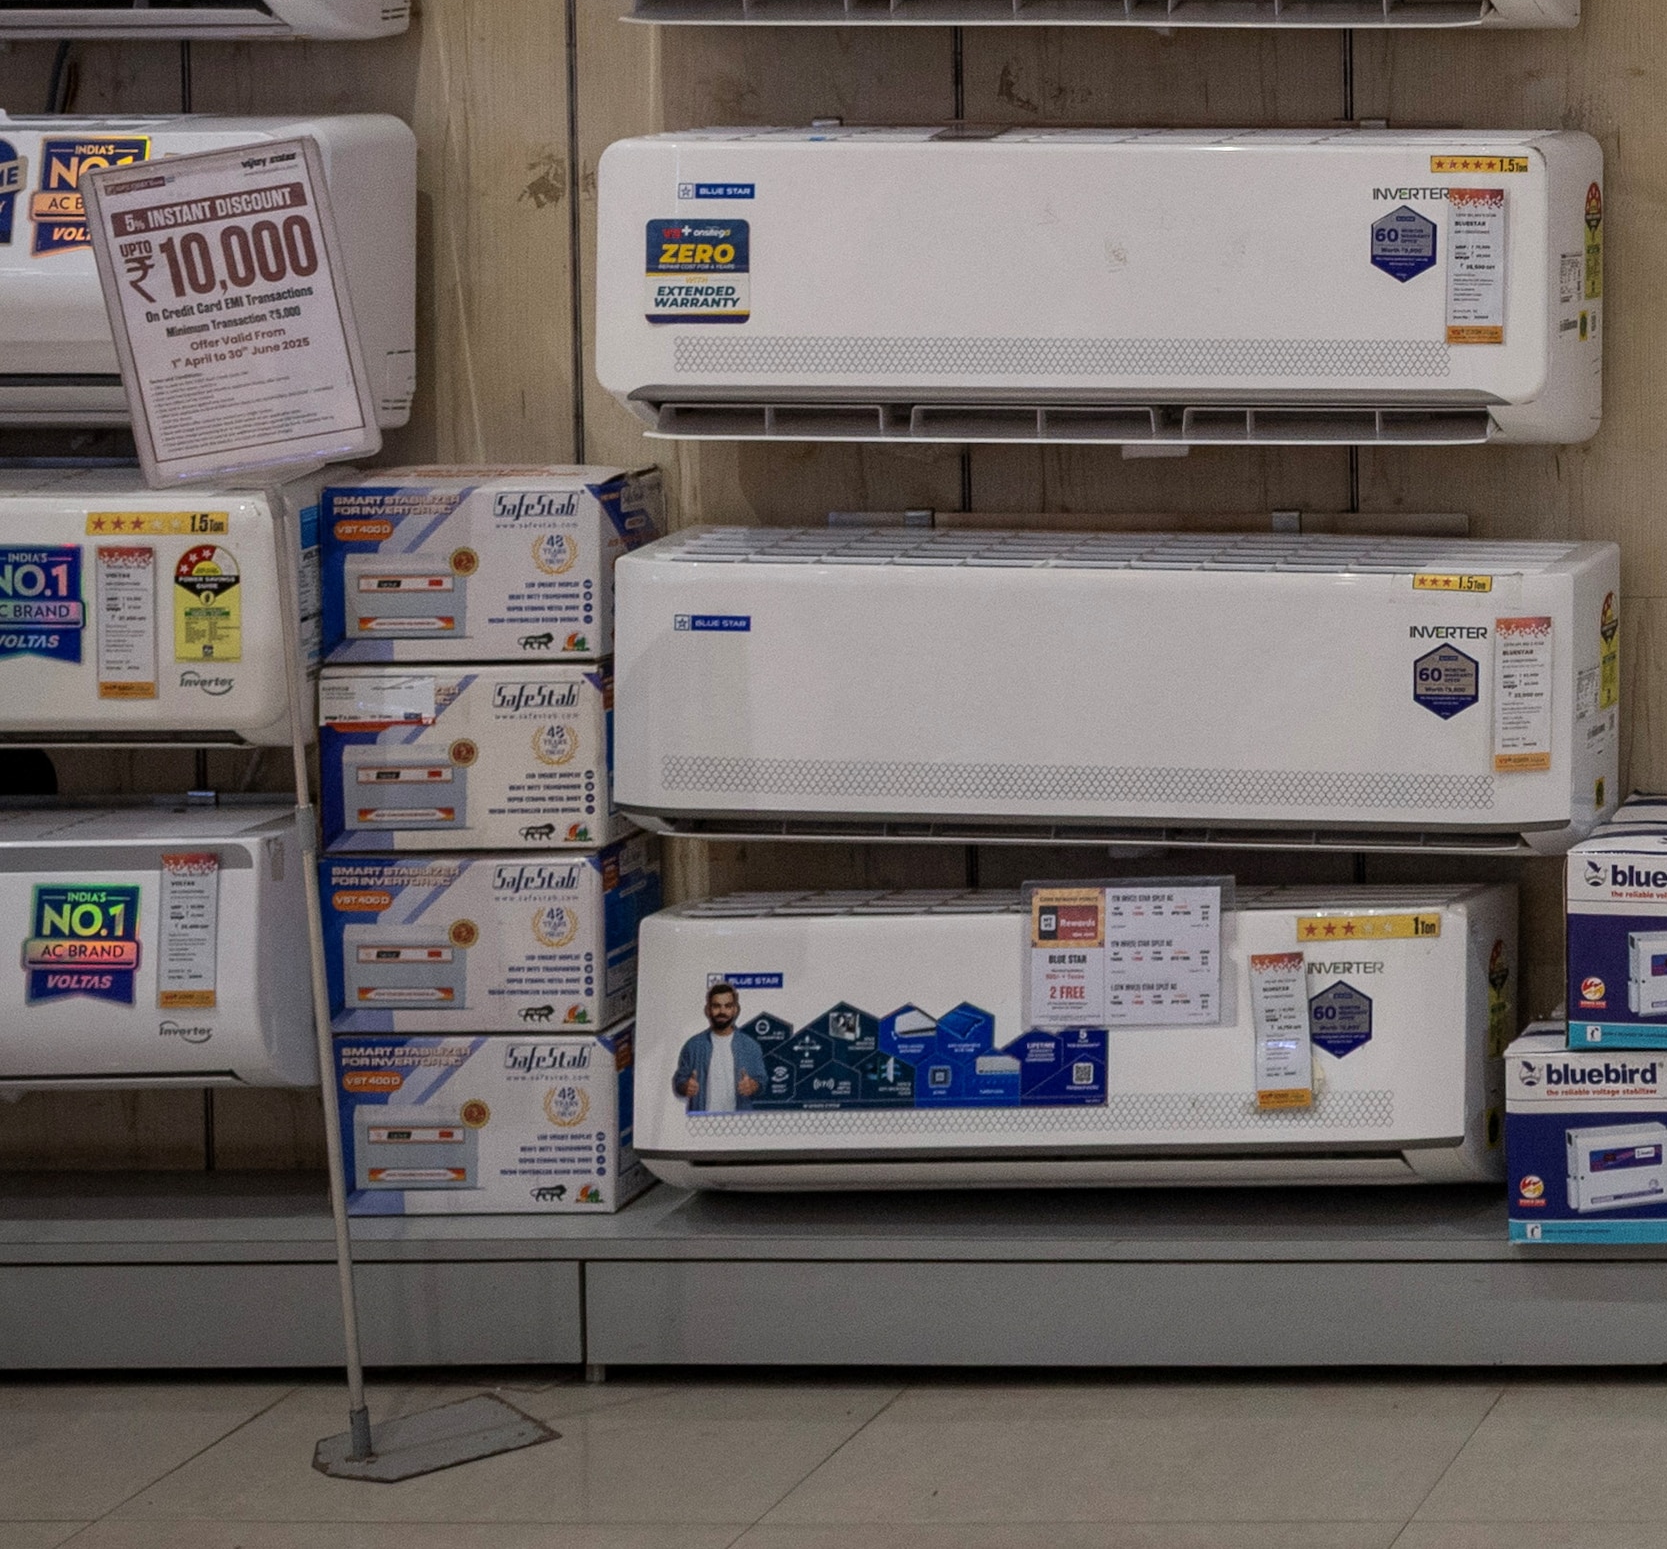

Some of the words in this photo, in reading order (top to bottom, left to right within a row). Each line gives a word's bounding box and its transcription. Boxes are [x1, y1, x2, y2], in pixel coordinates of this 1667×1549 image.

[75, 144, 114, 156] INDIA'S
[124, 213, 145, 231] 5%
[148, 201, 210, 228] INSTANT
[215, 187, 292, 216] DISCOUNT
[120, 240, 152, 257] UPTO
[660, 244, 735, 264] ZERO
[657, 286, 735, 296] EXTENDED
[146, 311, 160, 322] On
[162, 305, 193, 320] Credit
[196, 302, 222, 316] Card
[224, 298, 243, 311] EMI
[246, 285, 314, 308] Transactions
[654, 297, 740, 308] WARRANTY
[166, 320, 210, 338] Minimum
[211, 312, 266, 331] Transaction
[190, 338, 219, 351] Offer
[222, 332, 252, 347] Valid
[254, 327, 286, 342] From
[185, 351, 212, 368] April
[215, 352, 226, 363] to
[251, 344, 279, 358] June
[282, 336, 310, 351] 2025
[497, 494, 576, 519] SafeStab
[190, 515, 208, 533] 1.5
[209, 519, 224, 532] Ton
[1458, 577, 1473, 588] 1.5
[1474, 581, 1486, 590] Ton
[14, 605, 70, 618] BRAND
[496, 685, 577, 711] SafeStab
[68, 892, 107, 903] INDIA'S
[1625, 891, 1653, 899] reliable
[42, 905, 125, 936] NO.1
[41, 945, 66, 958] AC
[68, 945, 124, 958] BRAND
[46, 975, 113, 989] VOLTAS
[1546, 1063, 1657, 1085] bluebird
